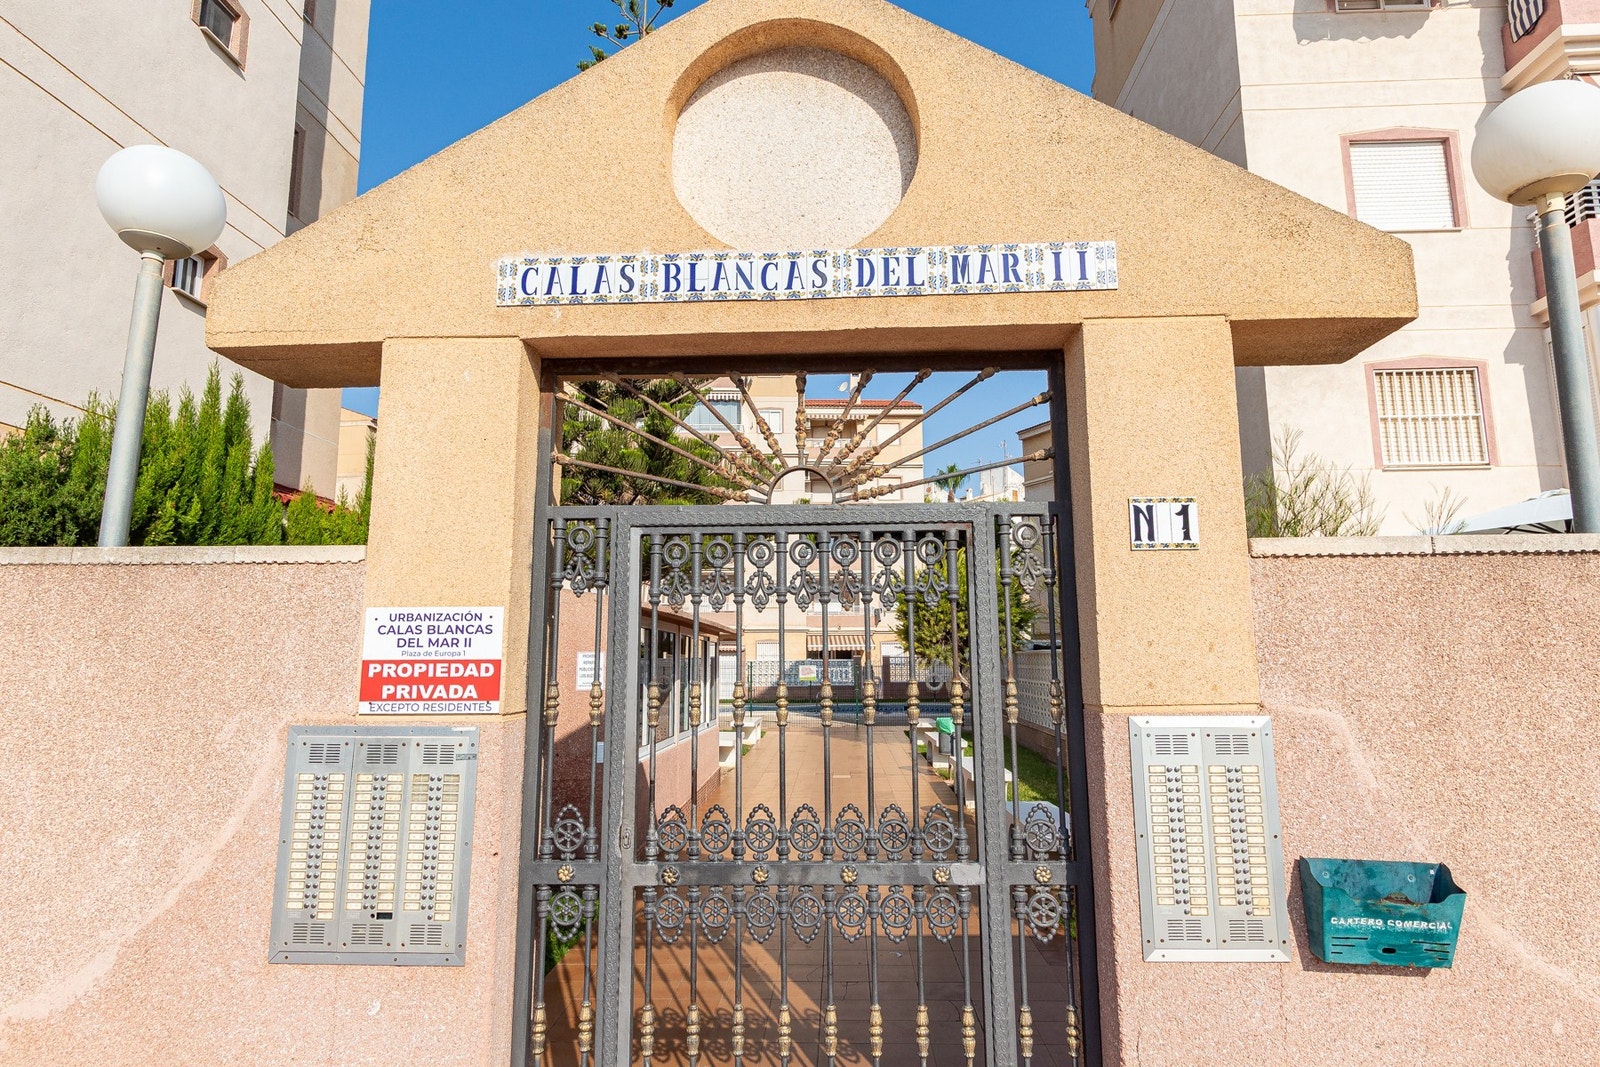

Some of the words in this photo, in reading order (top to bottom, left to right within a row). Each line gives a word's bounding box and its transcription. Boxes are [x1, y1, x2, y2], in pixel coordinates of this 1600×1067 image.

[521, 264, 635, 296] CALAS
[662, 259, 827, 293] BLANCAS
[855, 257, 925, 288] DEL
[950, 254, 1023, 285] MAR
[1051, 250, 1089, 282] II
[1174, 504, 1192, 541] 1
[389, 611, 483, 622] URBANIZACIÓN
[377, 625, 423, 635] CALAS
[427, 624, 493, 635] BLANCAS
[396, 638, 424, 648] DEL
[428, 638, 460, 648] MAR
[464, 637, 472, 648] II
[434, 650, 461, 658] Europa
[368, 663, 495, 678] PROPIEDAD
[381, 684, 478, 699] PRIVADA
[369, 703, 420, 712] EXCEPTO
[423, 702, 492, 712] RESIDENTES
[1331, 917, 1383, 926] CARTERO
[1387, 920, 1453, 930] COMERCIAL
